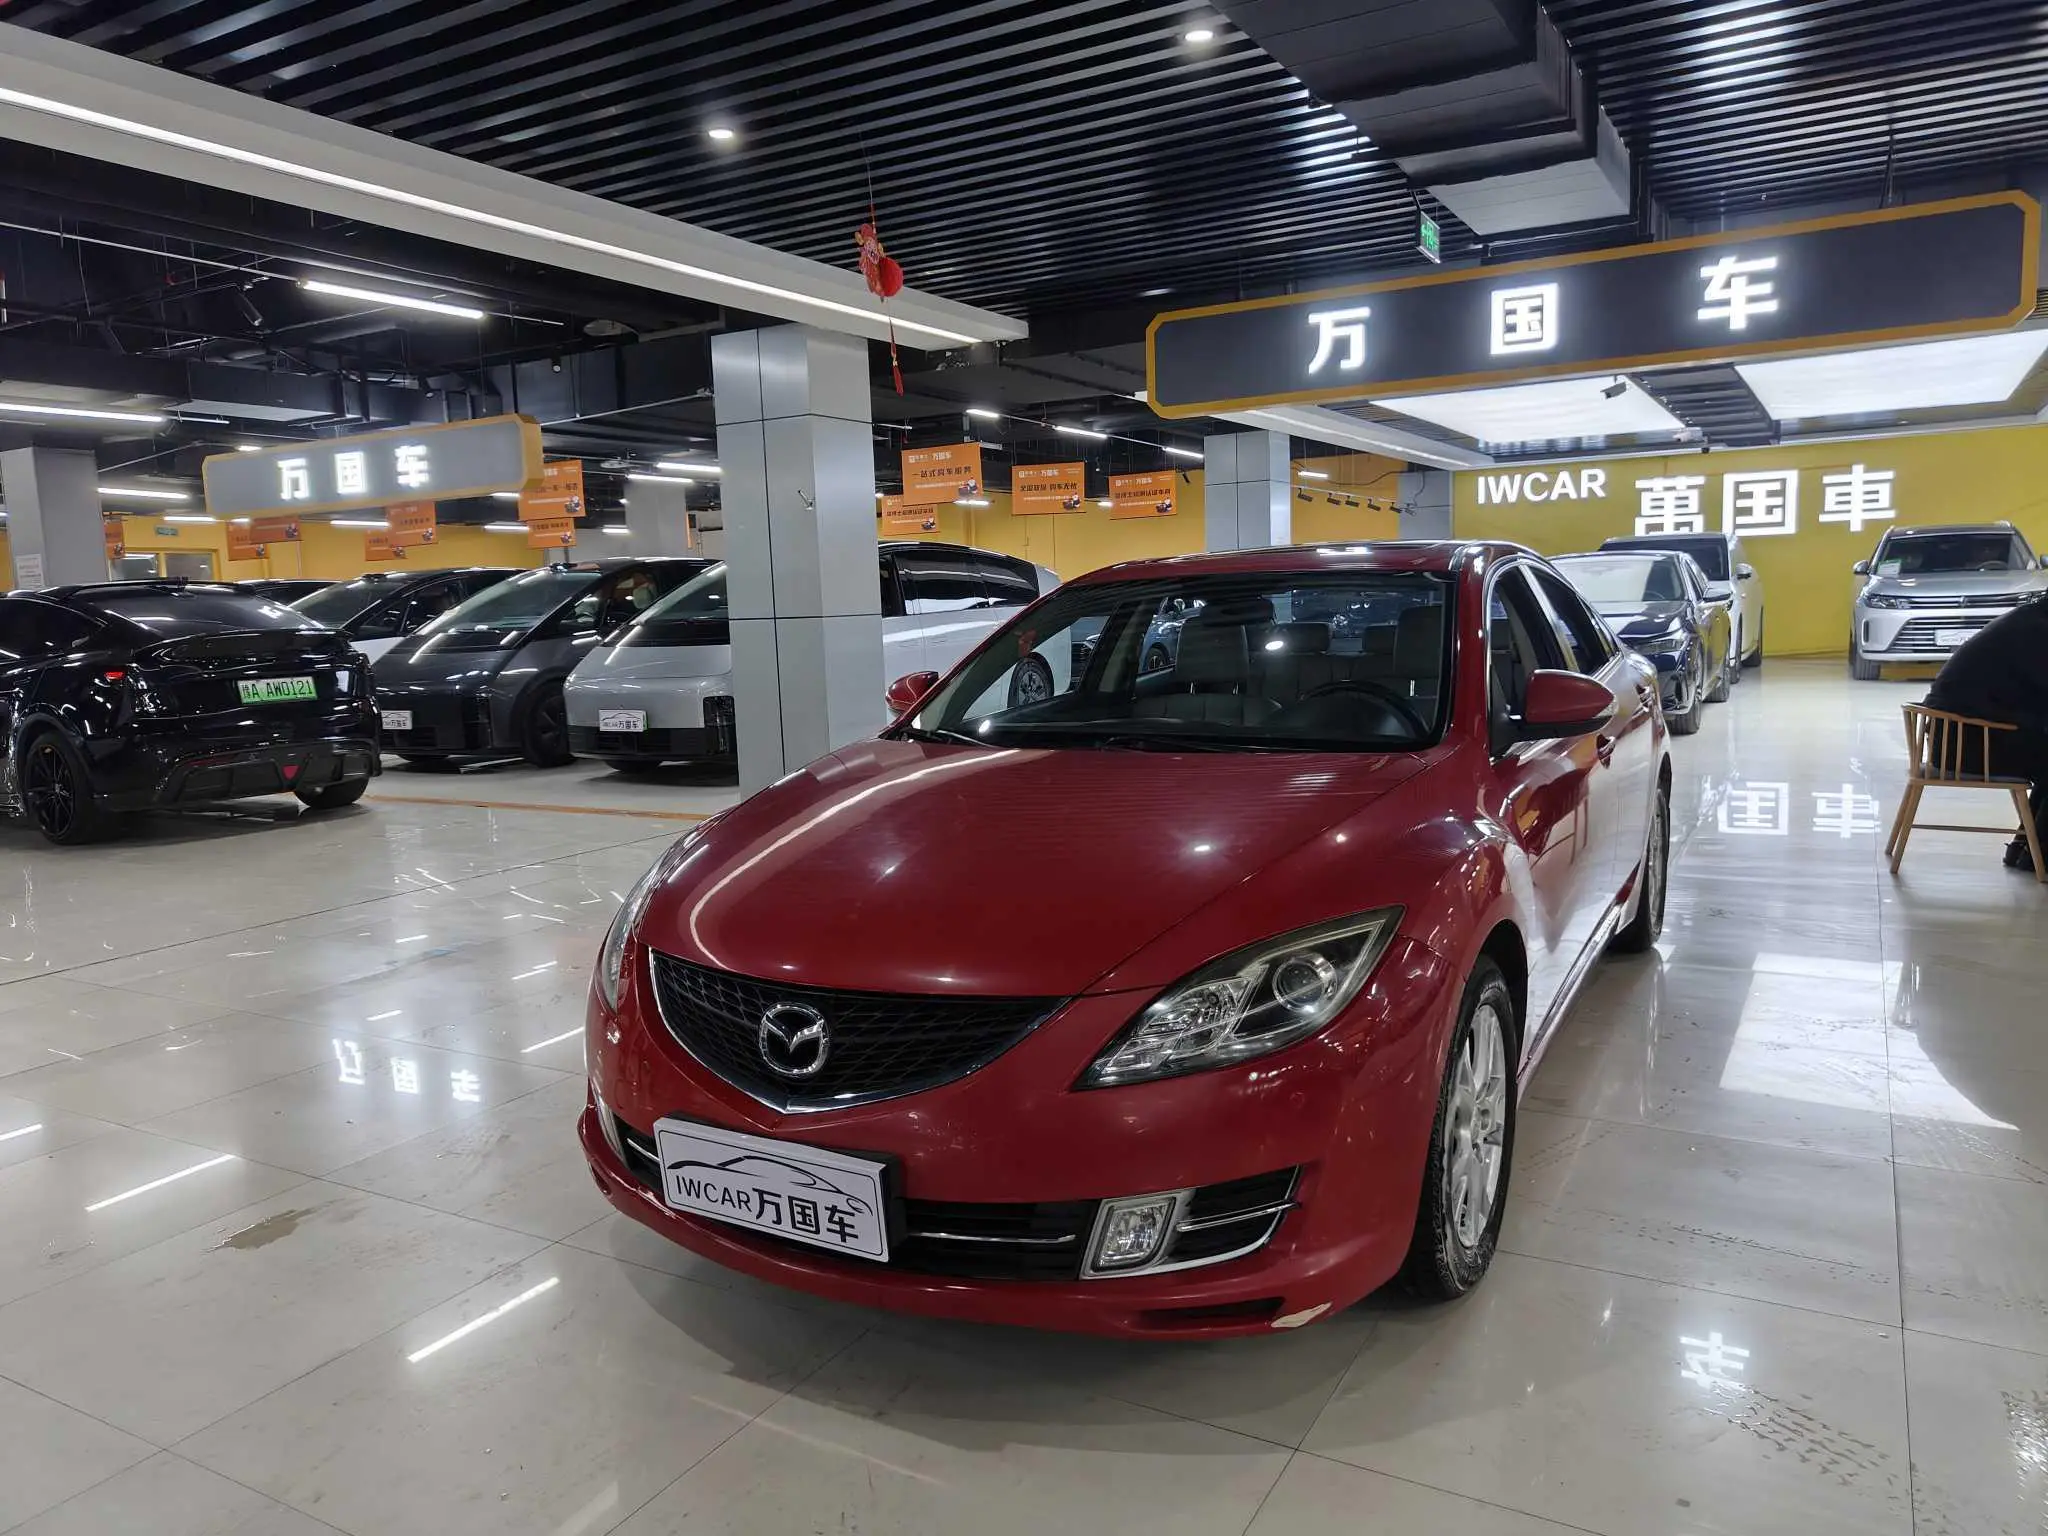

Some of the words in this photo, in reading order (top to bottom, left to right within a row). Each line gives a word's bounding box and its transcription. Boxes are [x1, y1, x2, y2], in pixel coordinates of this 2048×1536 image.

[1307, 255, 1778, 375] 万国车
[277, 444, 430, 500] 万国车
[1477, 467, 1608, 504] IWCAR
